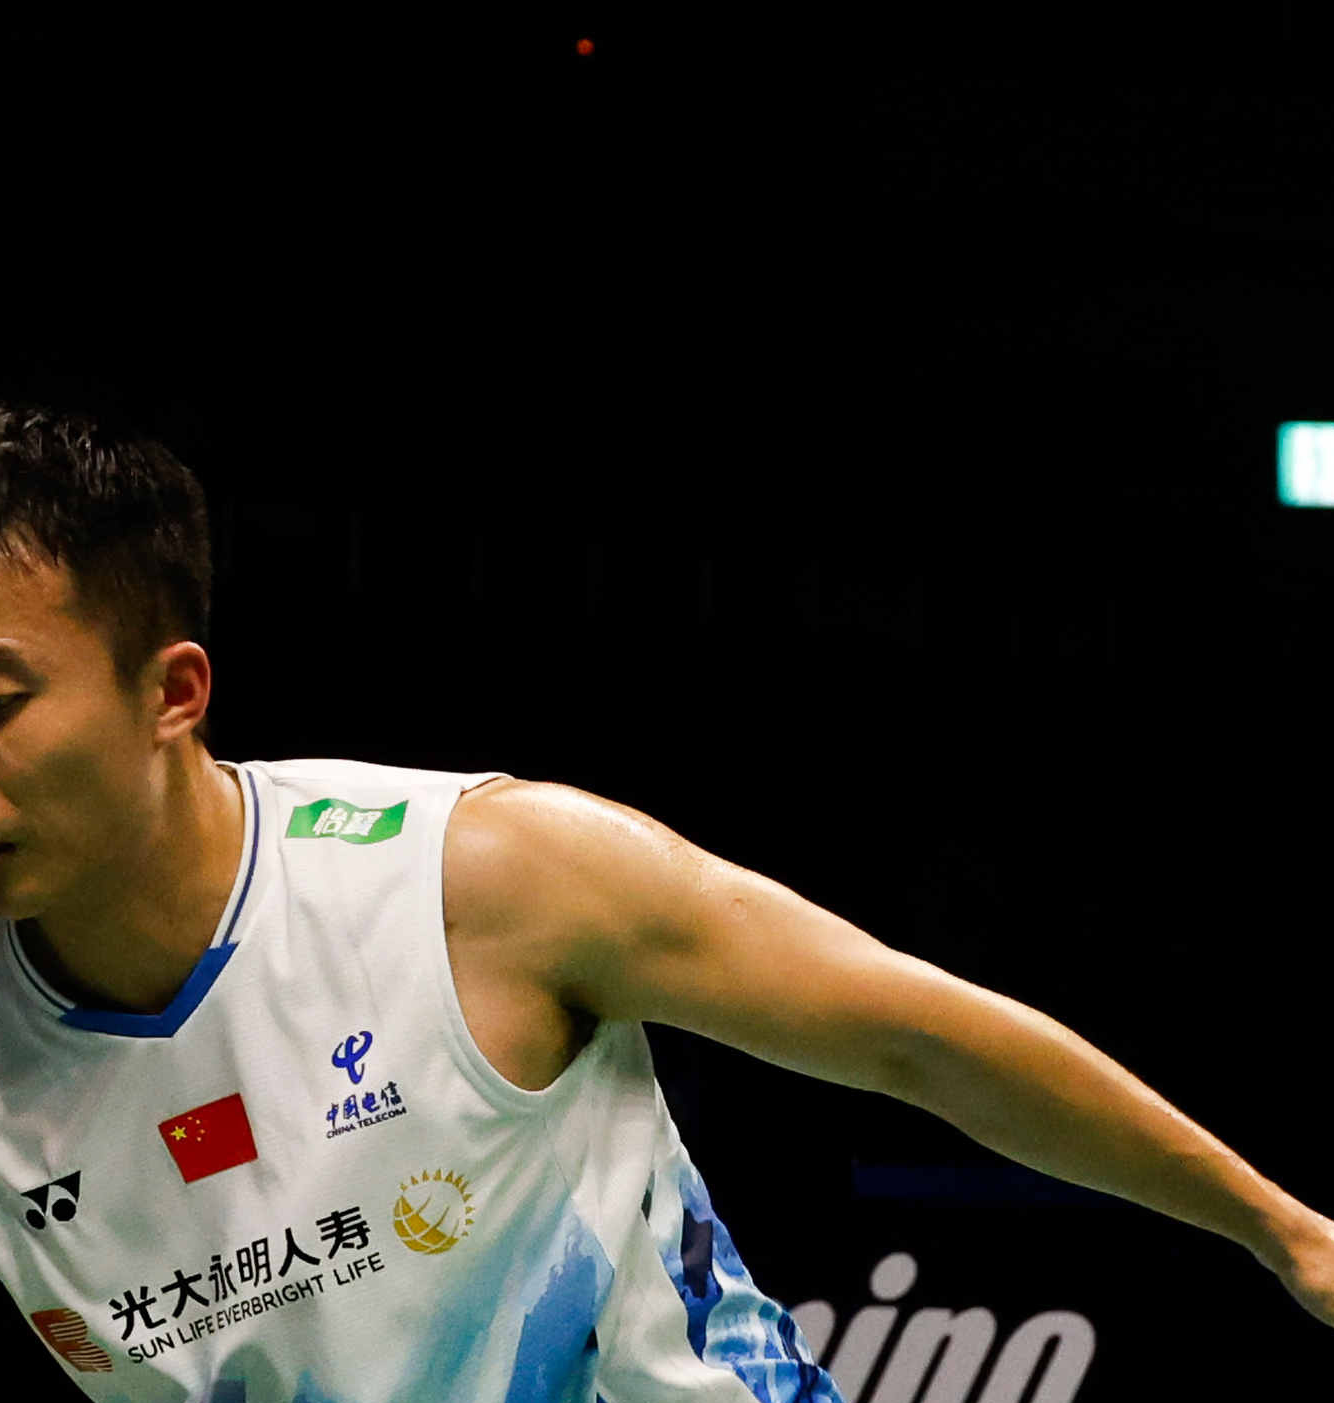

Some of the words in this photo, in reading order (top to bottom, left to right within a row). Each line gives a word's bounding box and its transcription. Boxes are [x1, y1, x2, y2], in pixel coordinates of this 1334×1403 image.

[326, 1081, 403, 1129] 中国电信
[326, 1123, 357, 1139] CHINA
[357, 1106, 407, 1129] TELECOM
[108, 1206, 371, 1341] 光大永明人寿
[128, 1333, 175, 1364] SUN
[177, 1315, 215, 1344] LIFE
[217, 1275, 324, 1330] EVERBRIGHT
[333, 1252, 385, 1286] LIFE
